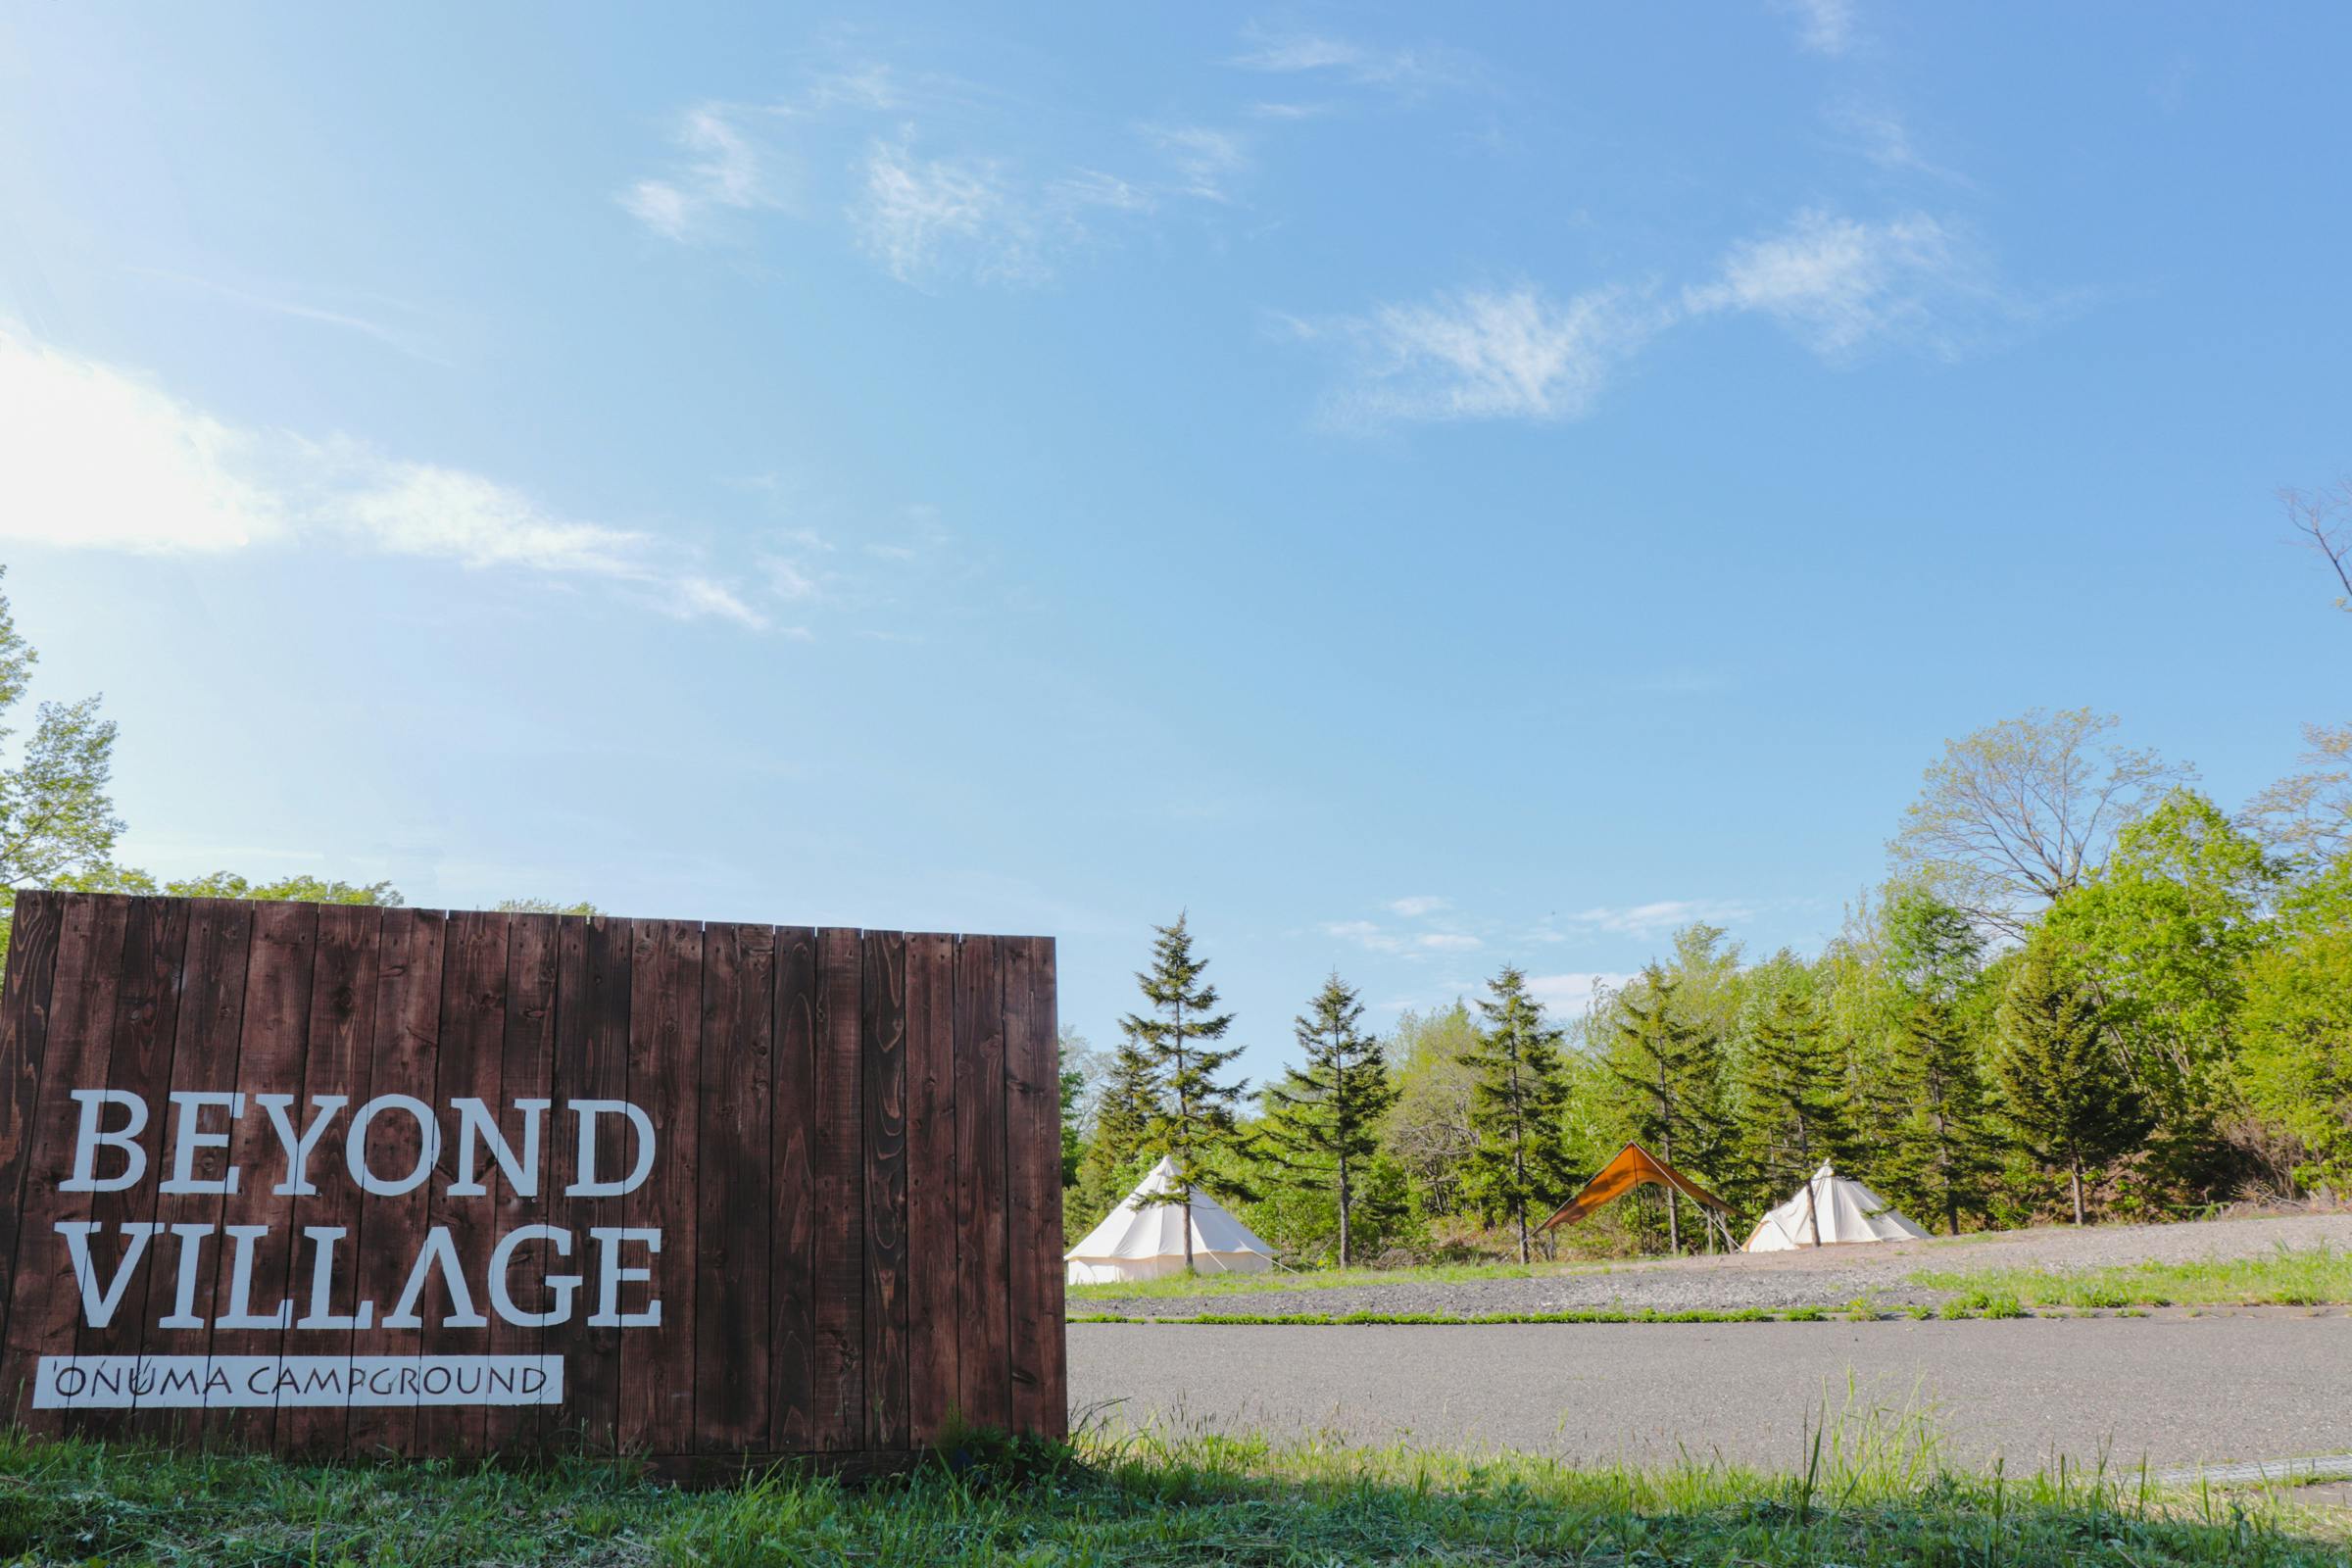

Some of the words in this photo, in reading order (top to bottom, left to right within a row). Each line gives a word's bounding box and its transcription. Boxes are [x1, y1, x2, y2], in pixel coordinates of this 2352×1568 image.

[59, 1090, 656, 1197] BEYOND
[54, 1221, 662, 1329] VILLAGE
[55, 1366, 232, 1397] ONUMA
[247, 1366, 548, 1396] CAMPGROUND
